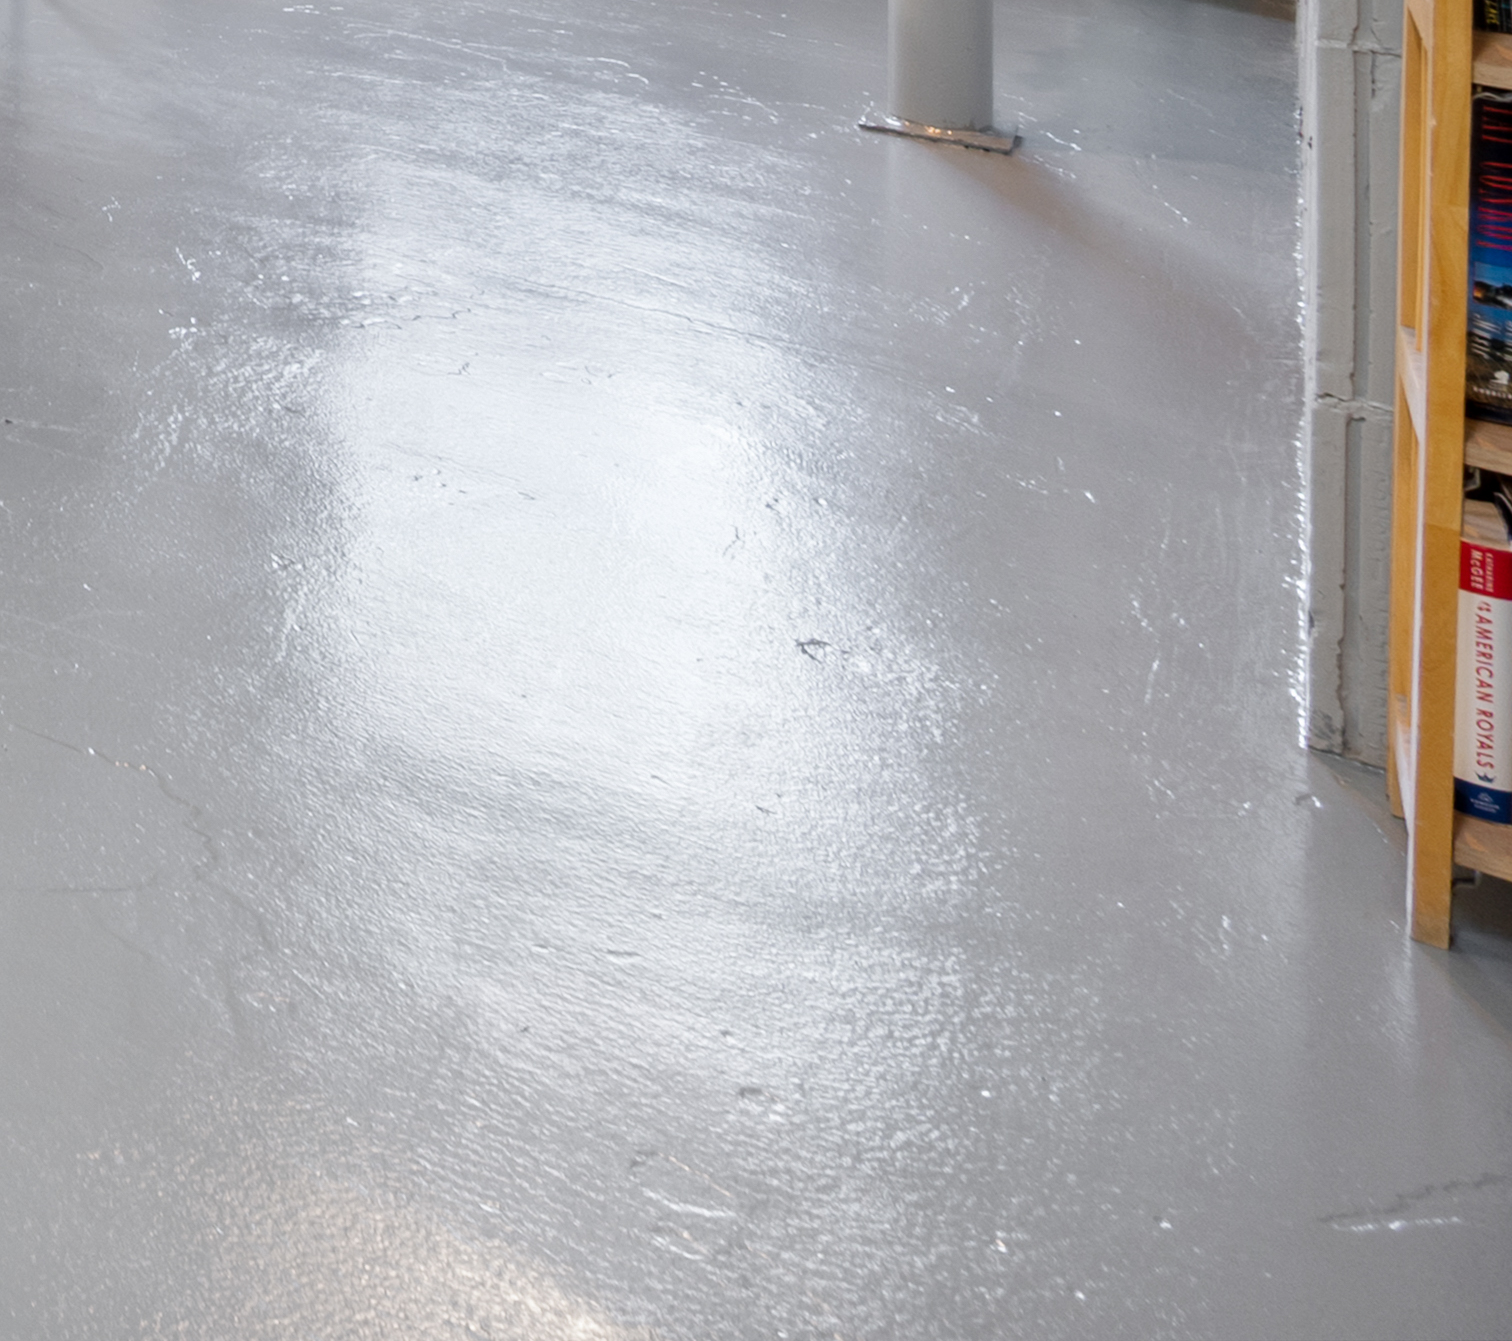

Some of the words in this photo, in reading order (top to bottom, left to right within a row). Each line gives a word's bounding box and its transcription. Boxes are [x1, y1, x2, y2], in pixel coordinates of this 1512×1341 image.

[1470, 548, 1484, 591] McGEE
[1474, 613, 1494, 703] AMERICAN
[1475, 708, 1495, 770] ROYALS
